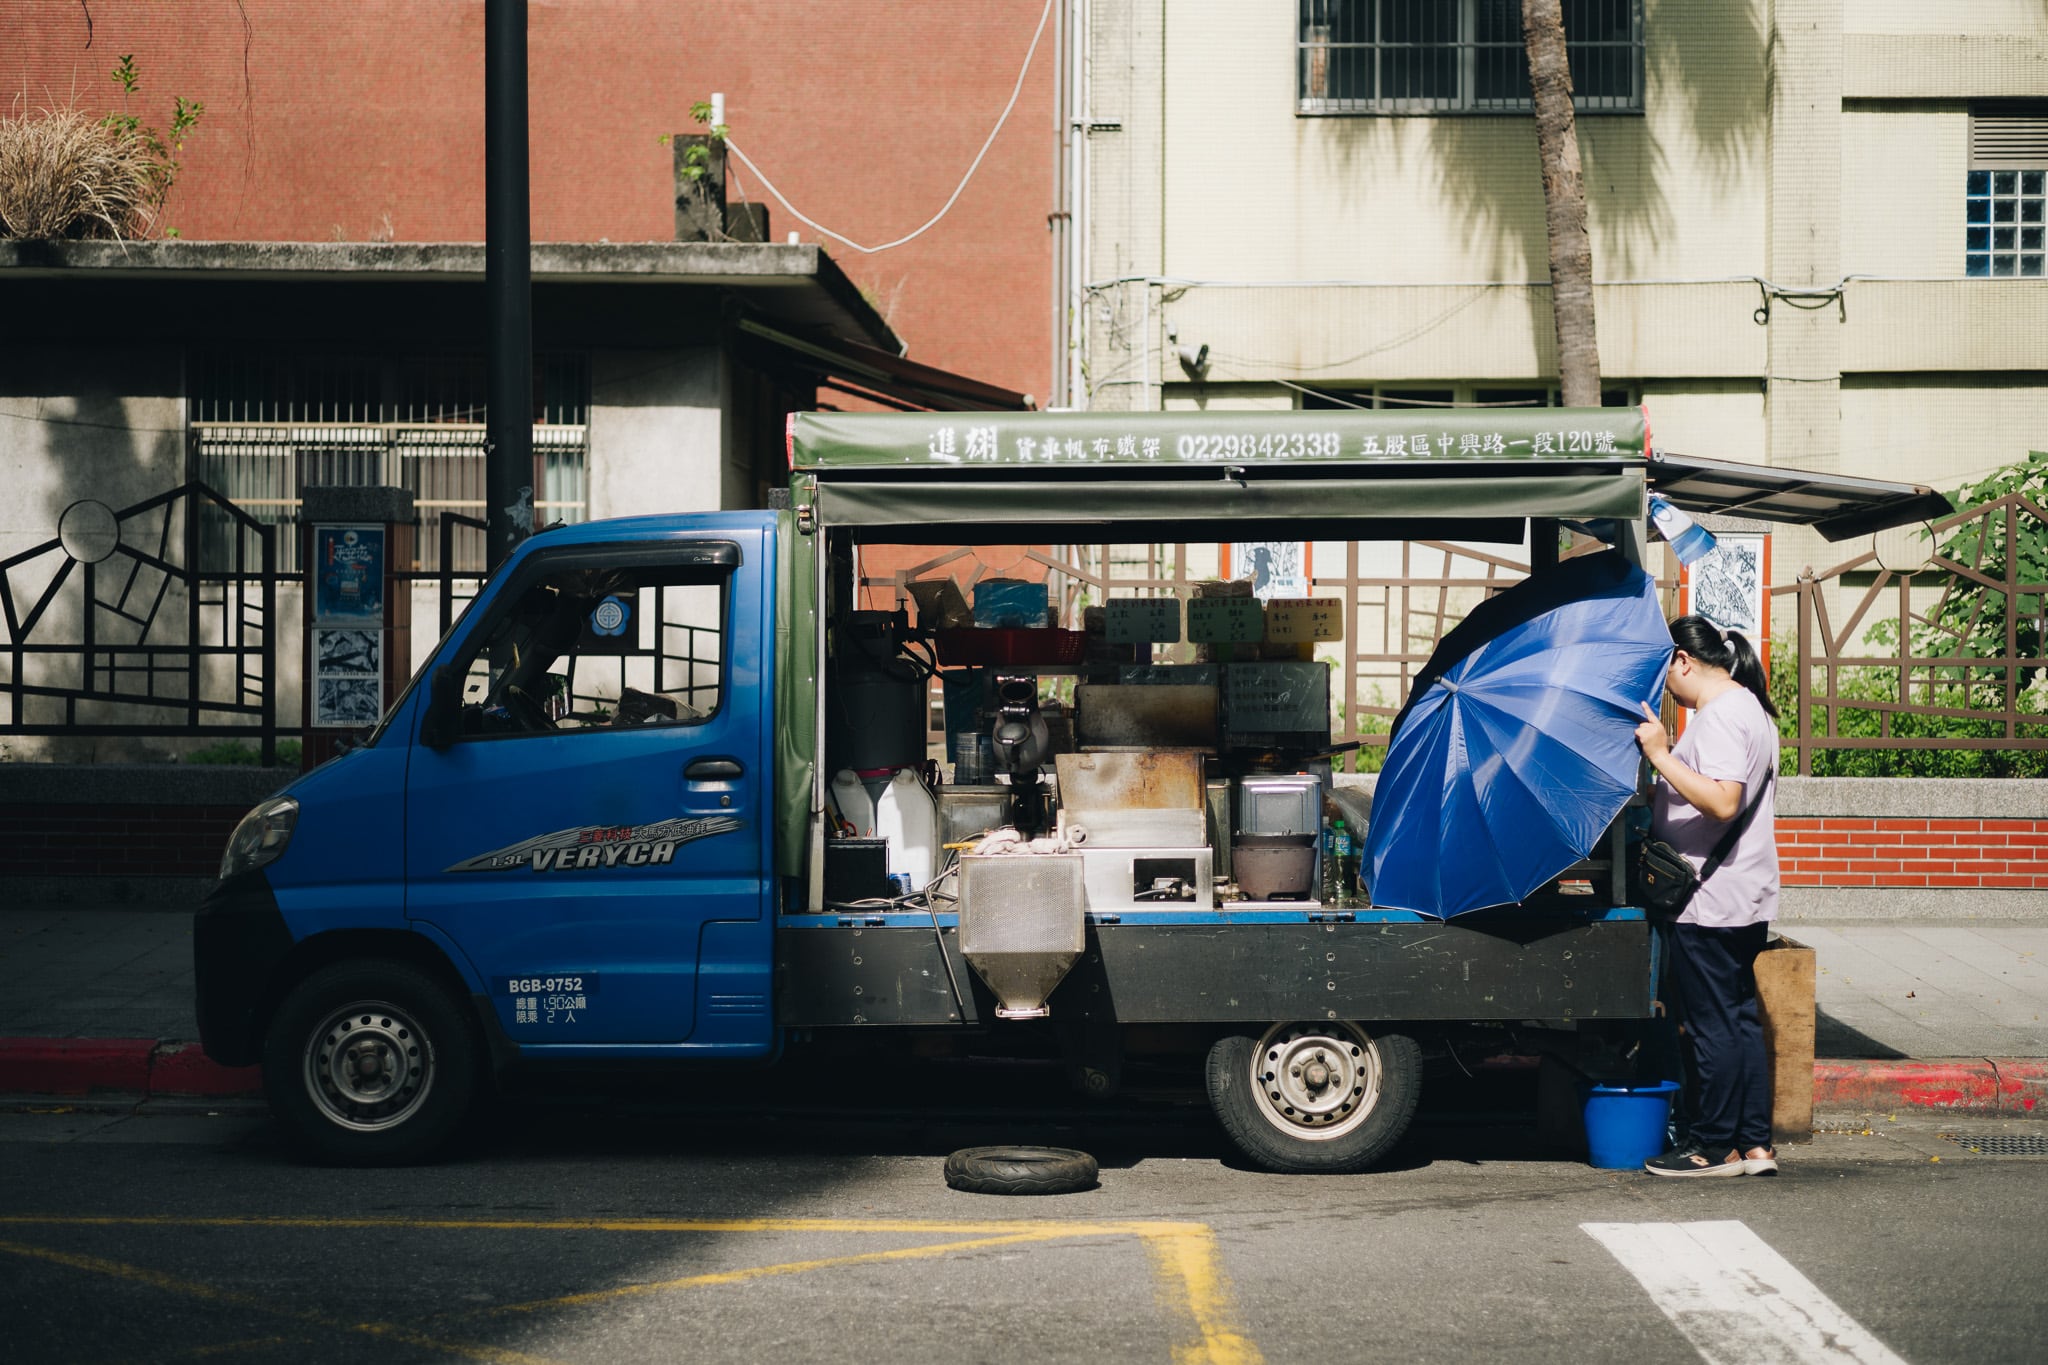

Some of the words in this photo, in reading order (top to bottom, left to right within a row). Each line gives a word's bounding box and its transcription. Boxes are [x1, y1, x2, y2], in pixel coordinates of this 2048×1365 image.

[1177, 431, 1340, 460] 0229842338
[1359, 430, 1617, 457] 五股區中興路一段120號
[489, 855, 525, 868] 1.3L
[531, 841, 677, 872] VERYCA
[509, 978, 583, 993] BGB-9752
[565, 1010, 576, 1024] 人
